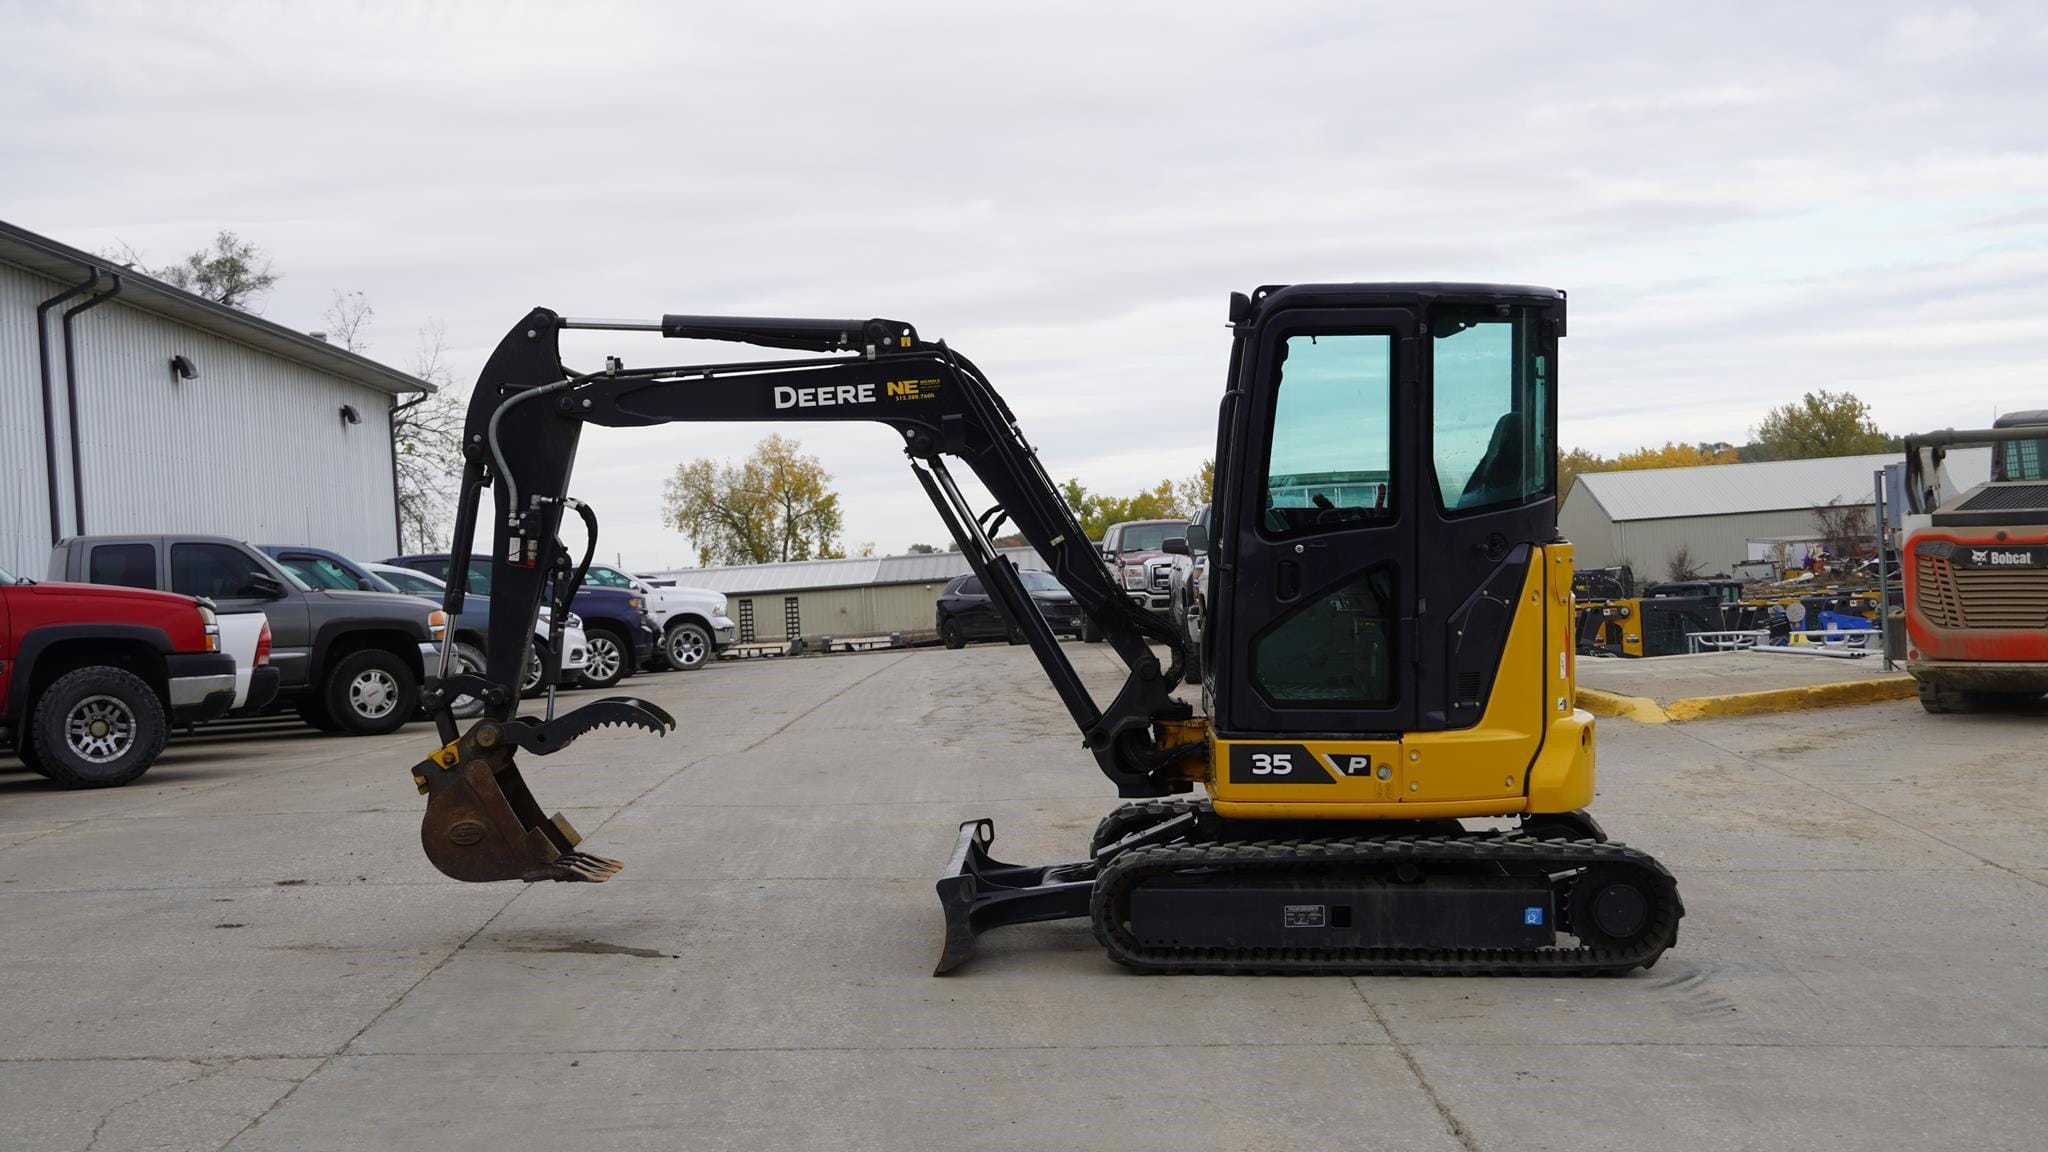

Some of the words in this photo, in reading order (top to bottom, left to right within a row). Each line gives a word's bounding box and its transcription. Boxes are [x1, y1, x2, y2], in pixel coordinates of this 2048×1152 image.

[774, 383, 877, 409] DEERE
[887, 379, 919, 396] NE
[1991, 552, 2031, 564] Bobcat
[1252, 754, 1293, 775] 35
